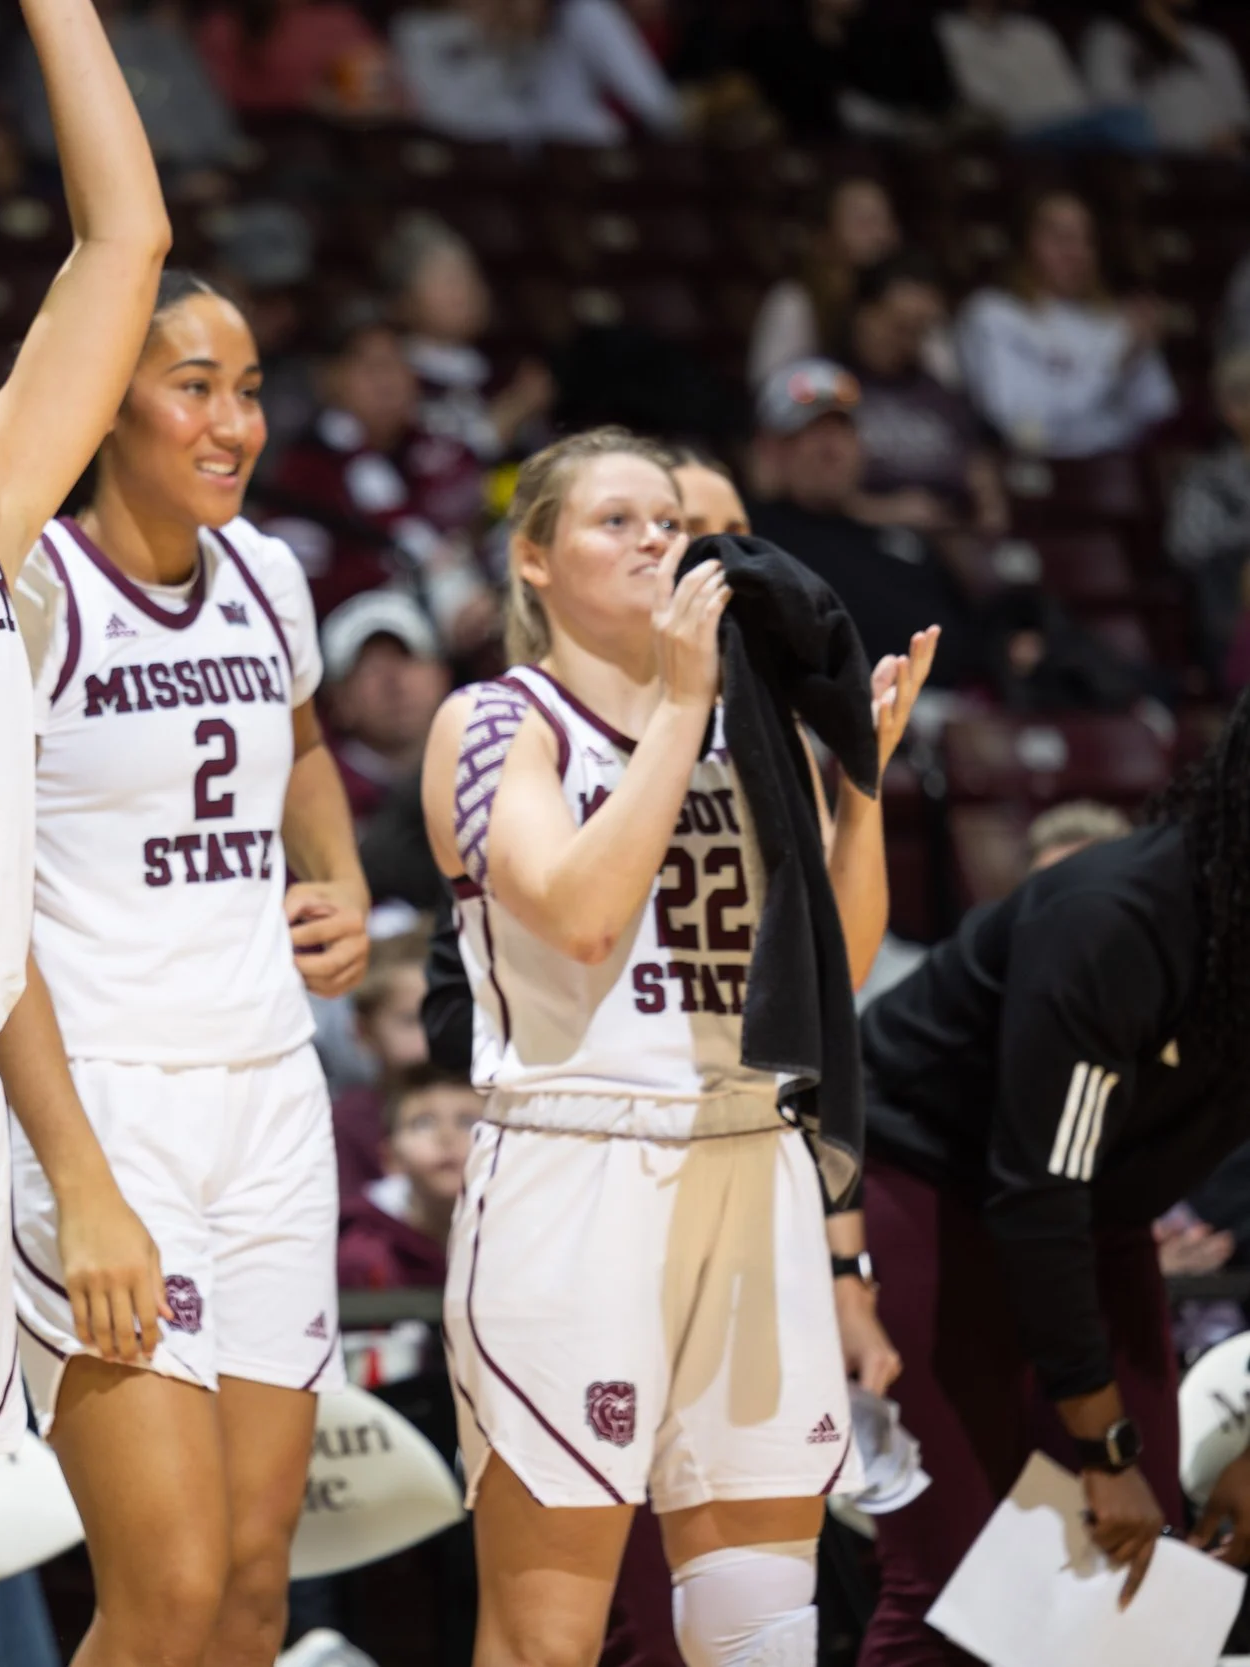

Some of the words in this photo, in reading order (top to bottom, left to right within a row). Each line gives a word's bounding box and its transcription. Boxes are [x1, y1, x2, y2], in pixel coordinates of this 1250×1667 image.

[194, 718, 238, 821] 2
[654, 846, 752, 951] 22
[632, 961, 745, 1015] STAT
